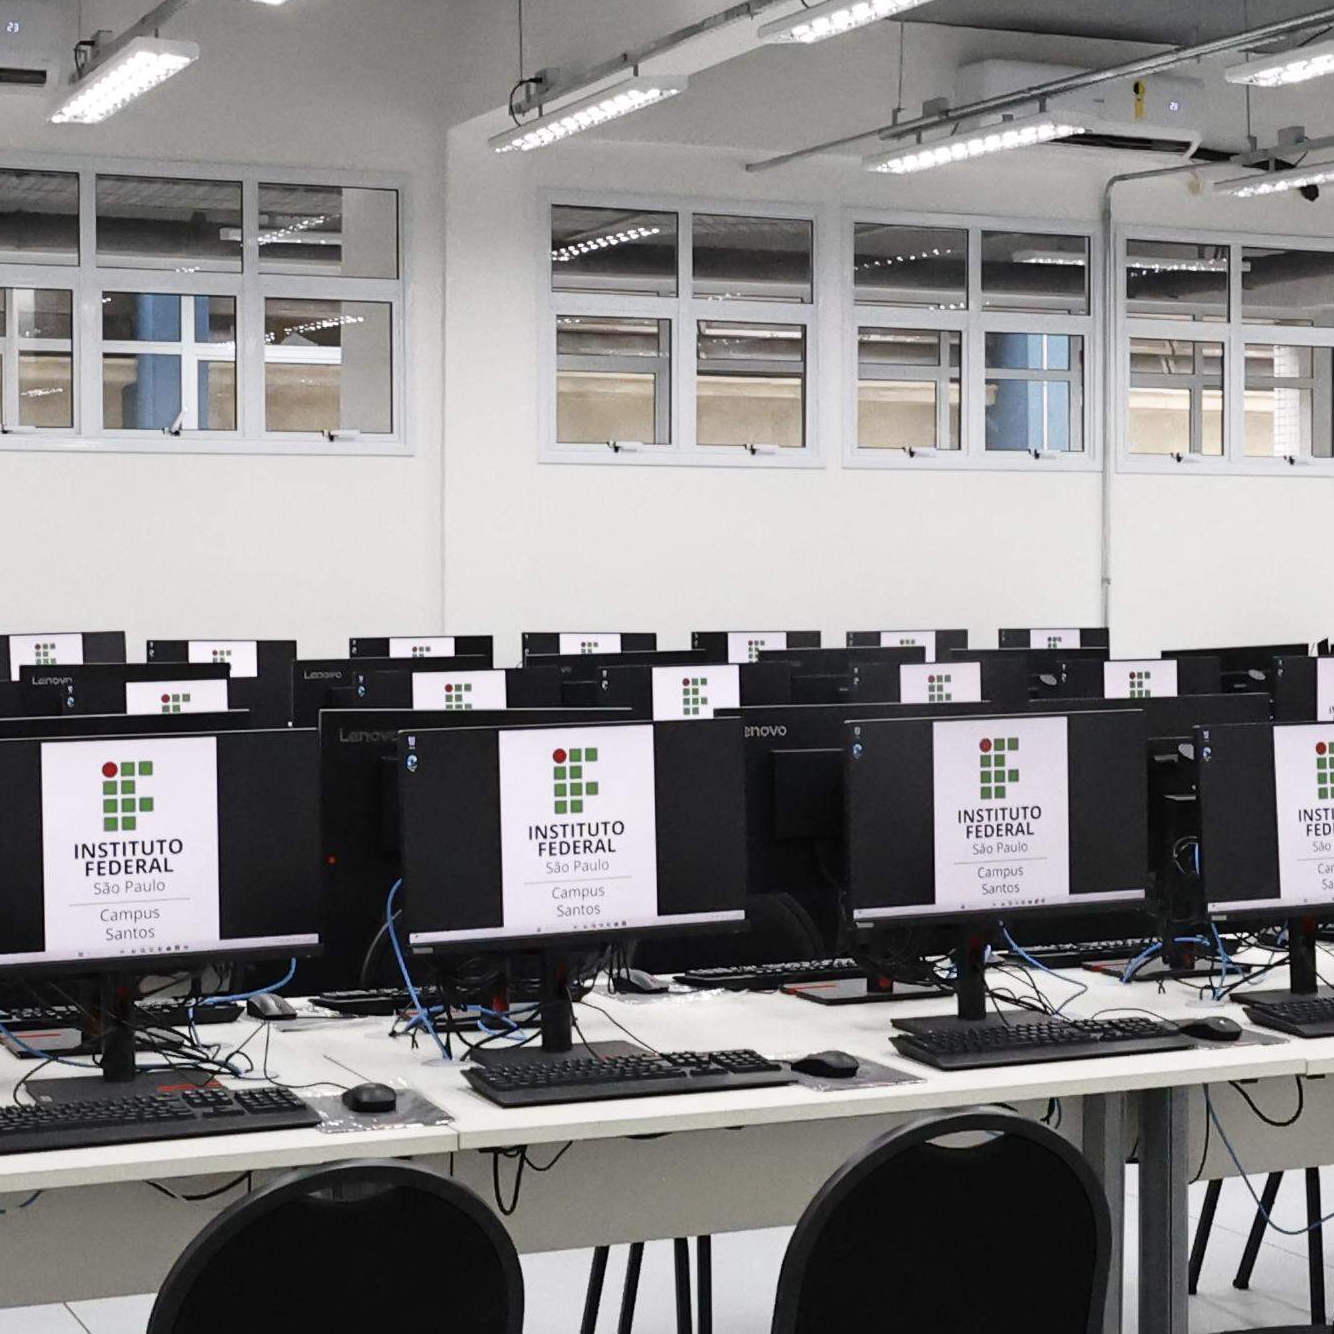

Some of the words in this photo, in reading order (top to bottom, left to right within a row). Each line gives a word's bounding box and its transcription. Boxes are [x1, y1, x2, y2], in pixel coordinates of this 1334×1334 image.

[744, 725, 787, 737] enovo
[957, 805, 1042, 824] INSTITUTO
[528, 820, 625, 840] INSTITUTO
[966, 821, 1035, 839] FEDERAL
[74, 838, 183, 860] INSTITUTO
[538, 838, 617, 857] FEDERAL
[972, 842, 993, 855] São
[996, 841, 1028, 854] Paulo
[1312, 841, 1331, 853] São
[85, 857, 174, 877] FEDERAL
[546, 861, 570, 874] São
[573, 858, 610, 873] Paulo
[977, 866, 1024, 879] Campus
[93, 881, 120, 896] São
[125, 878, 166, 893] Paulo
[551, 886, 605, 901] Campus
[981, 883, 1020, 896] Santos
[100, 908, 161, 923] Campus
[556, 904, 601, 917] Santos
[106, 927, 155, 941] Santos
